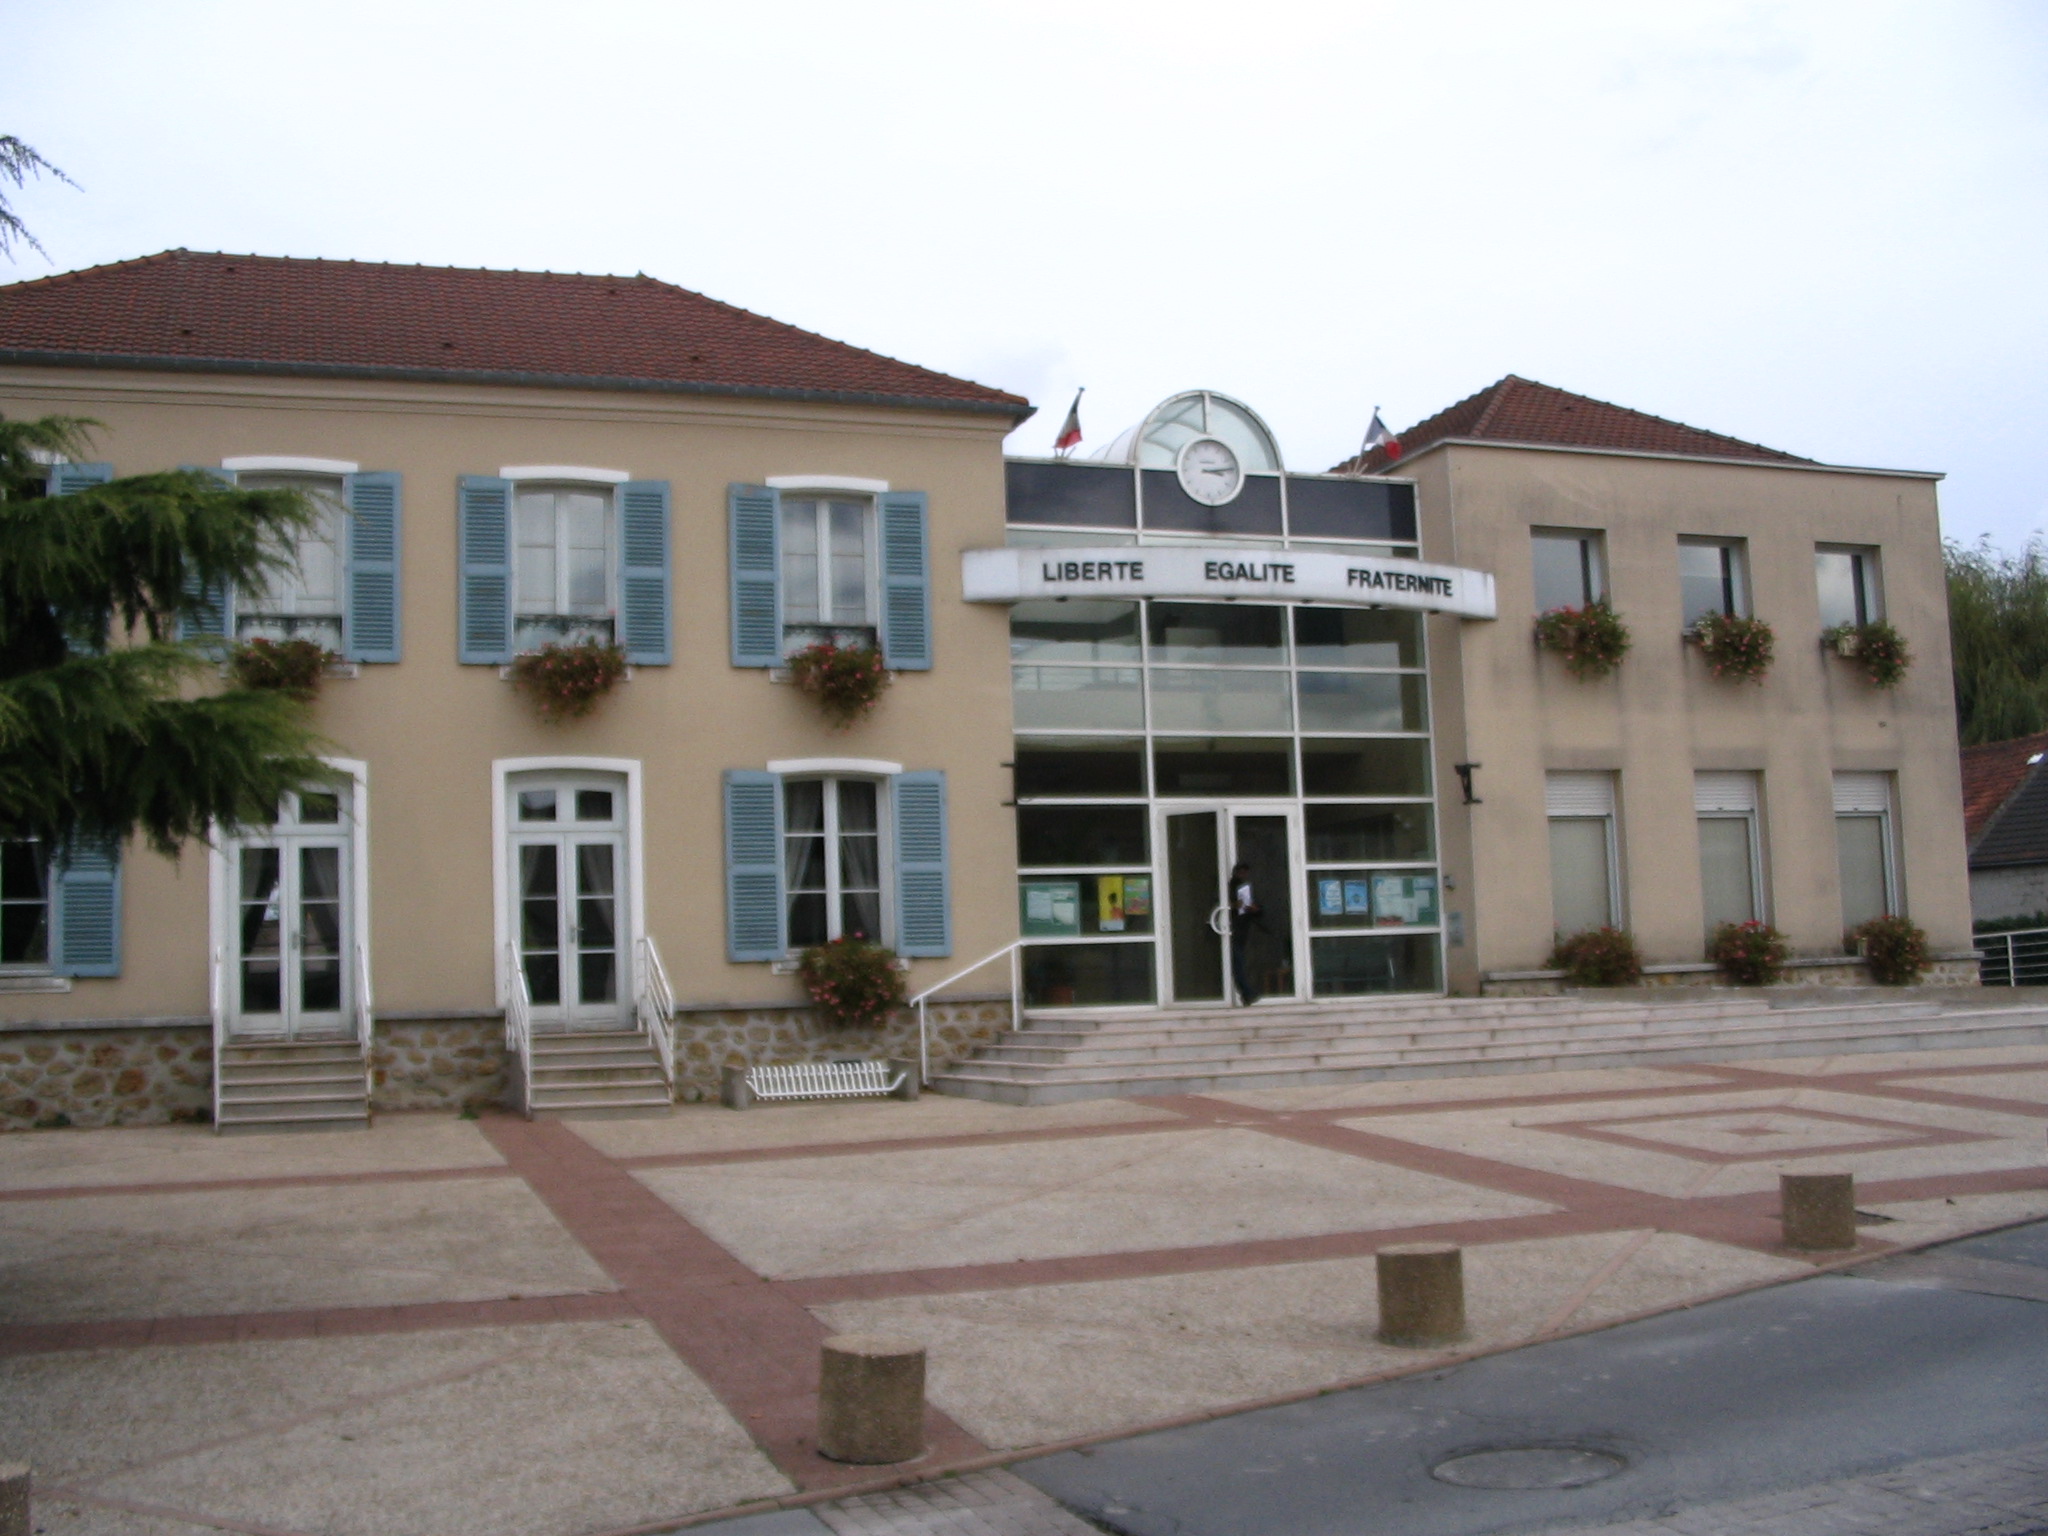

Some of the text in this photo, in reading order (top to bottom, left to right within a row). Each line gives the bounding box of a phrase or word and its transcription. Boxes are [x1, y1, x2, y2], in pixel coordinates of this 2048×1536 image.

[1042, 561, 1453, 597] LIBERTE EGALITE FRATERNITE
